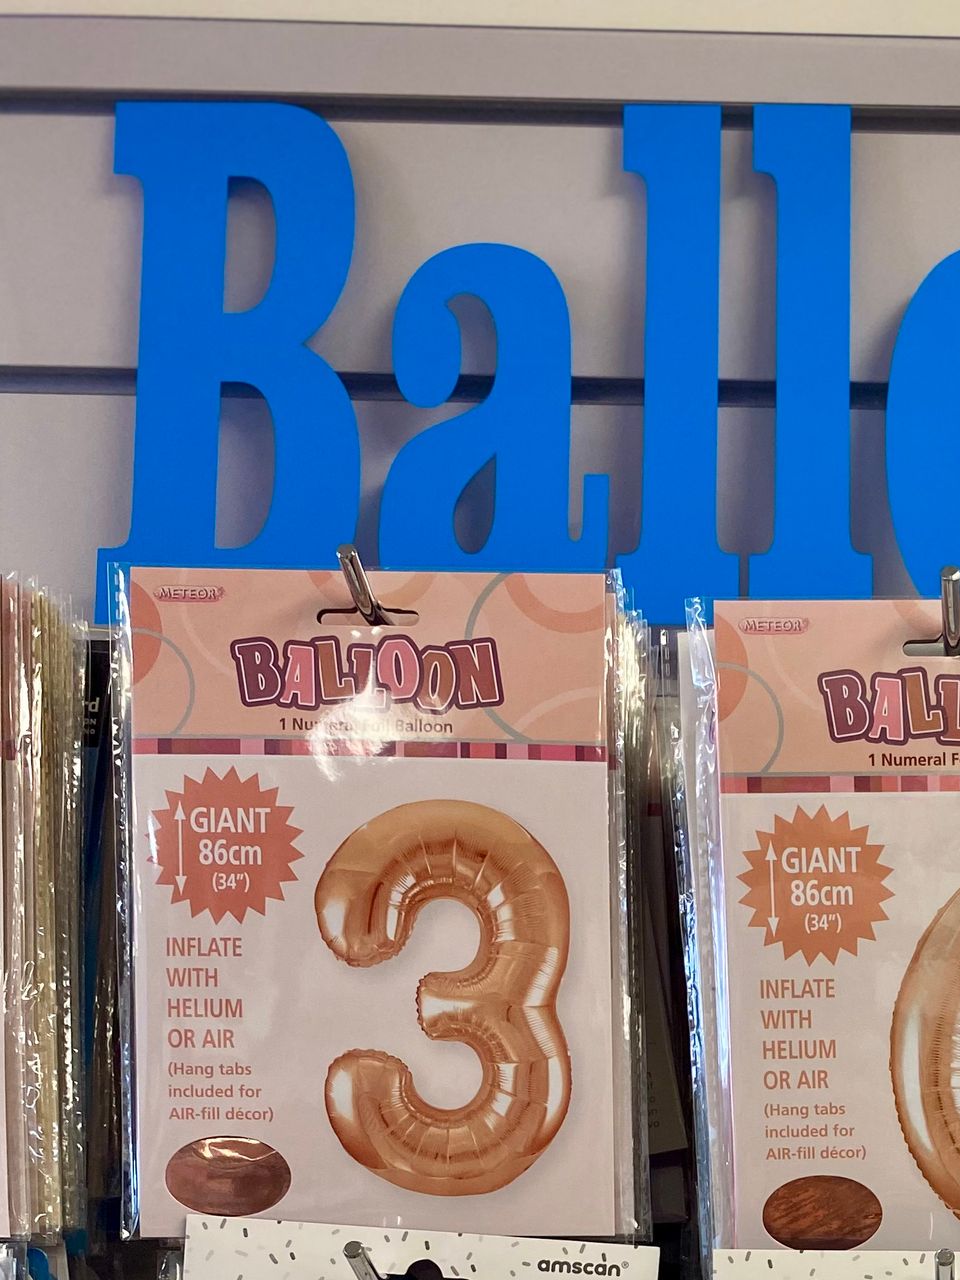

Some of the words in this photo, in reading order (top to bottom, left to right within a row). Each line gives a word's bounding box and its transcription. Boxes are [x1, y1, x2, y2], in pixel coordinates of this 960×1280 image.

[157, 586, 217, 600] METEOR
[743, 619, 802, 632] METEOR
[231, 635, 504, 715] BALLOON
[279, 718, 287, 731] 1
[395, 718, 453, 734] Balloon
[868, 754, 876, 767] 1
[881, 752, 947, 767] Numeral
[189, 806, 272, 833] GIANT
[198, 839, 262, 866] 86cm
[781, 846, 862, 874] GIANT
[789, 879, 854, 907] 86cm
[165, 937, 243, 957] INFLATE
[165, 967, 219, 988] WITH
[759, 978, 835, 999] INFLATE
[167, 998, 243, 1019] HELIUM
[760, 1009, 812, 1030] WITH
[167, 1028, 196, 1049] OR
[202, 1028, 235, 1048] AIR
[762, 1039, 837, 1060] HELIUM
[167, 1061, 215, 1080] (Hang
[218, 1062, 253, 1077] tabs
[763, 1070, 792, 1090] OR
[796, 1069, 829, 1089] AIR
[168, 1084, 234, 1099] included
[237, 1084, 262, 1099] for
[168, 1106, 221, 1121] AIR-fill
[225, 1106, 274, 1123] décor)
[763, 1103, 809, 1120] (Hang
[812, 1102, 846, 1117] tabs
[764, 1124, 829, 1139] included
[832, 1124, 855, 1138] for
[765, 1146, 816, 1161] AIR-fill
[820, 1145, 867, 1161] décor)
